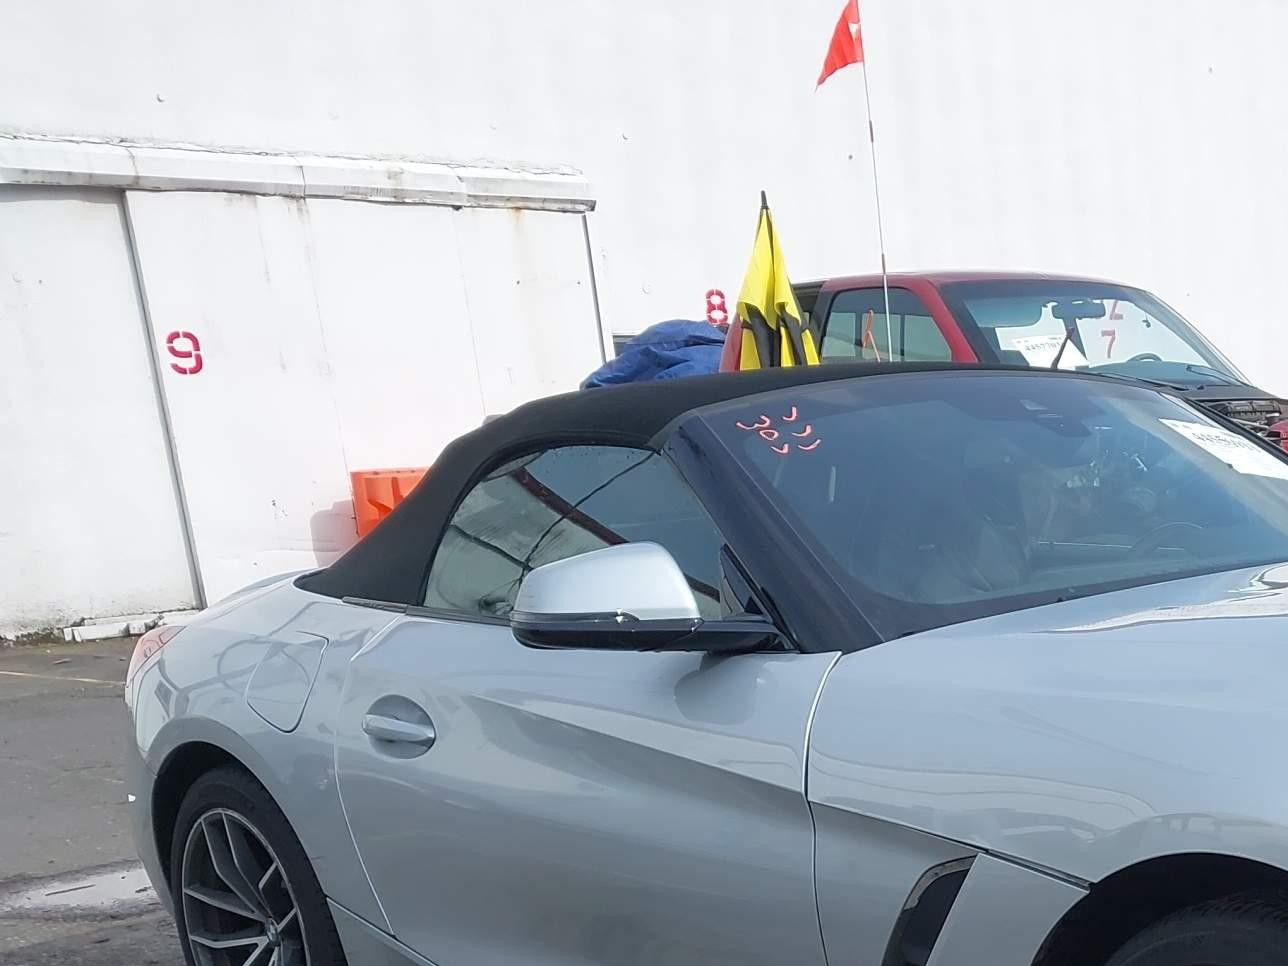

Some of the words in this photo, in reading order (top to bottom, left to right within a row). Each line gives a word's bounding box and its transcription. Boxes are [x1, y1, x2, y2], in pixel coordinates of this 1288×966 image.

[705, 288, 729, 324] 8
[166, 331, 203, 375] 9
[1101, 329, 1117, 359] 7
